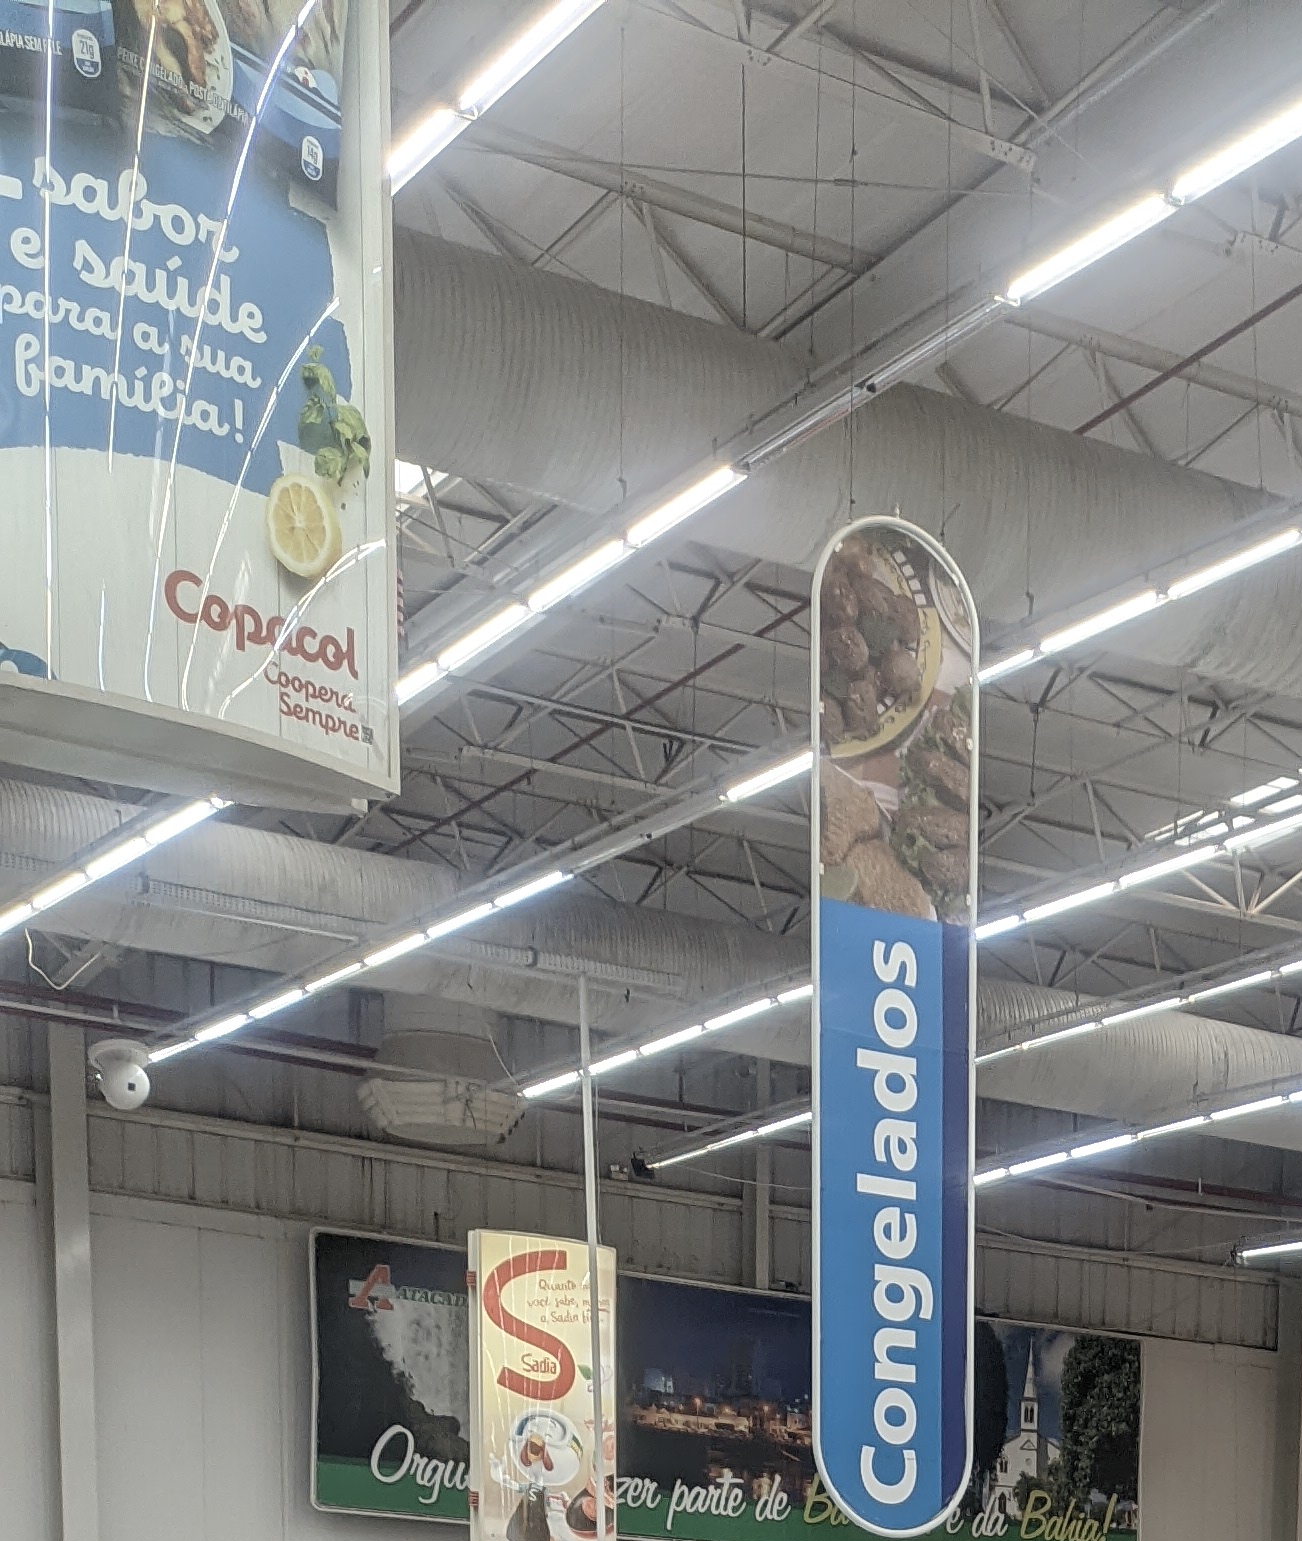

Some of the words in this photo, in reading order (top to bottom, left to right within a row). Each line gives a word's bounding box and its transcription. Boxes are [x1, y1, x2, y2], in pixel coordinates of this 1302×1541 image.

[39, 156, 240, 263] sabor
[10, 227, 46, 270] e
[73, 240, 268, 344] saúde
[15, 333, 244, 444] família!
[133, 322, 170, 355] a
[180, 334, 262, 389] sua
[164, 568, 360, 681] Copacol
[262, 662, 358, 714] Coopera
[278, 690, 360, 743] Sempre
[856, 938, 936, 1505] Congelados
[521, 1353, 557, 1375] Sadia
[667, 1470, 746, 1531] parte
[755, 1473, 792, 1521] de
[971, 1496, 1009, 1538] da
